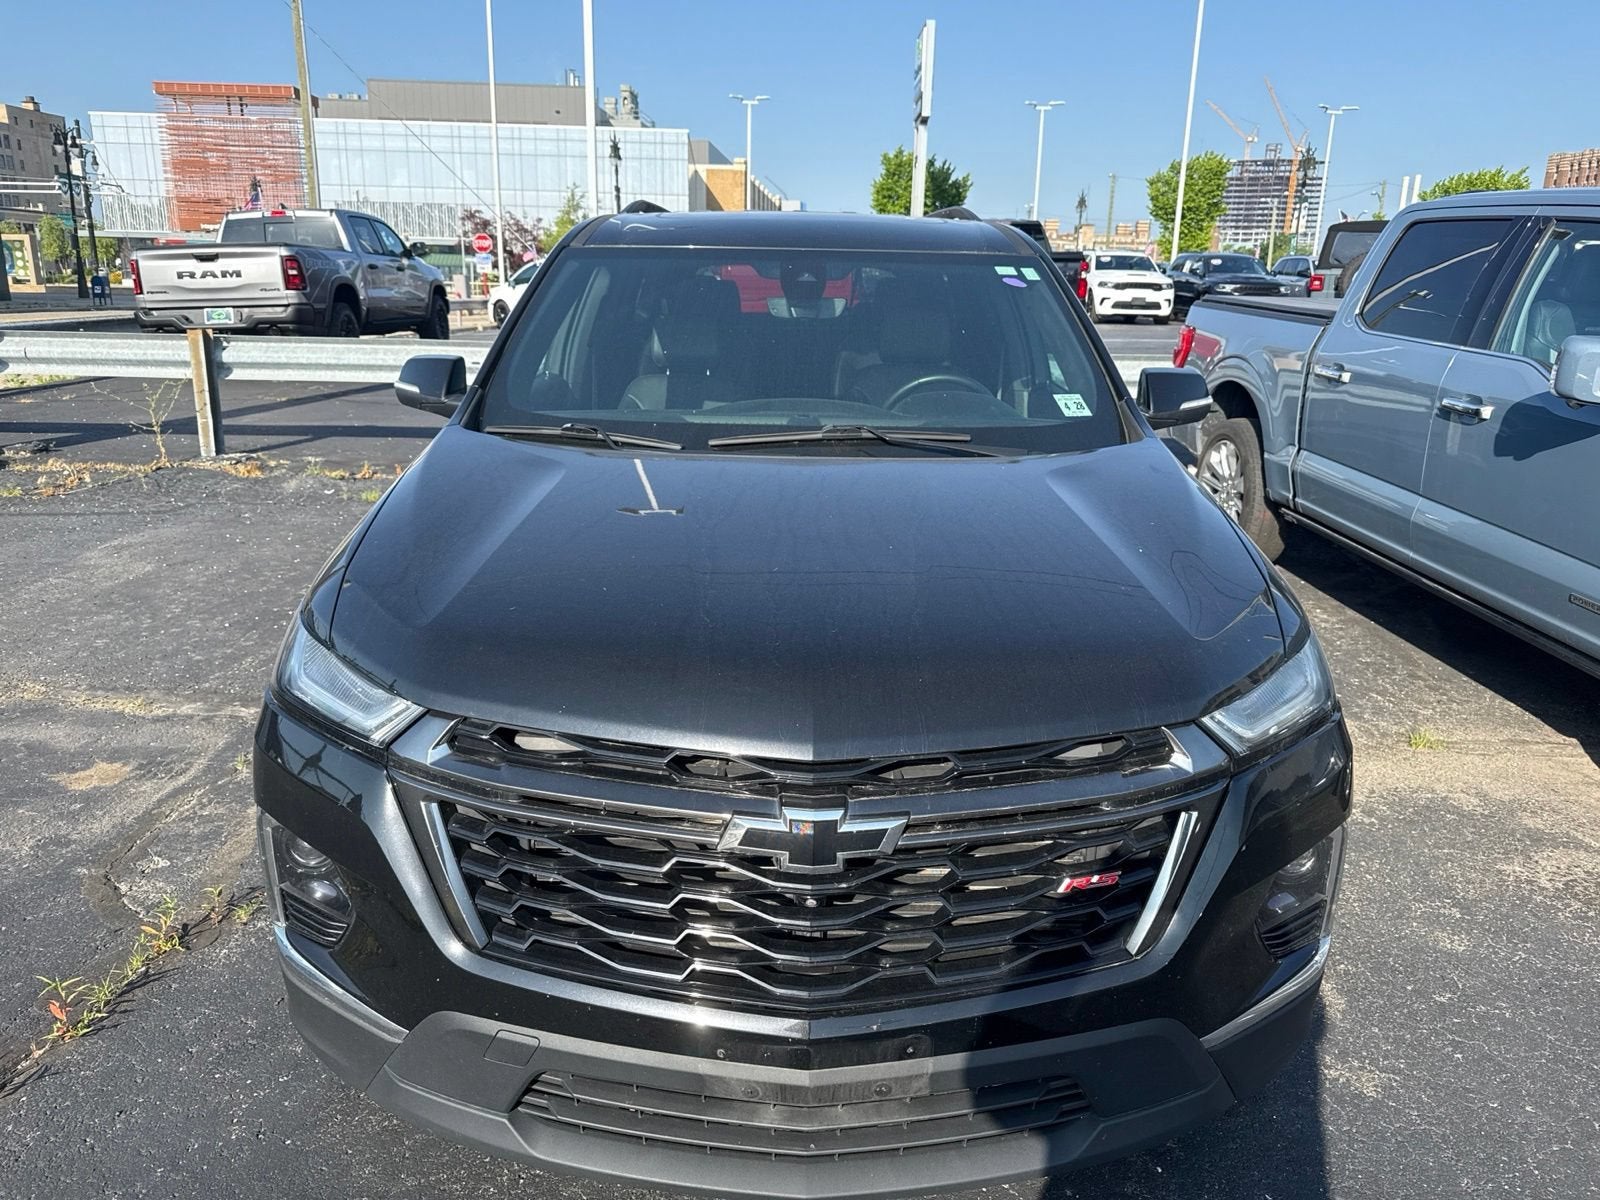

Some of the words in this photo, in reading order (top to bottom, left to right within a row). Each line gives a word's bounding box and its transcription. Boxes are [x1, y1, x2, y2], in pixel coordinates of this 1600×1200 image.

[176, 270, 242, 279] RAM
[1065, 402, 1071, 410] 4
[1057, 871, 1121, 893] RS
